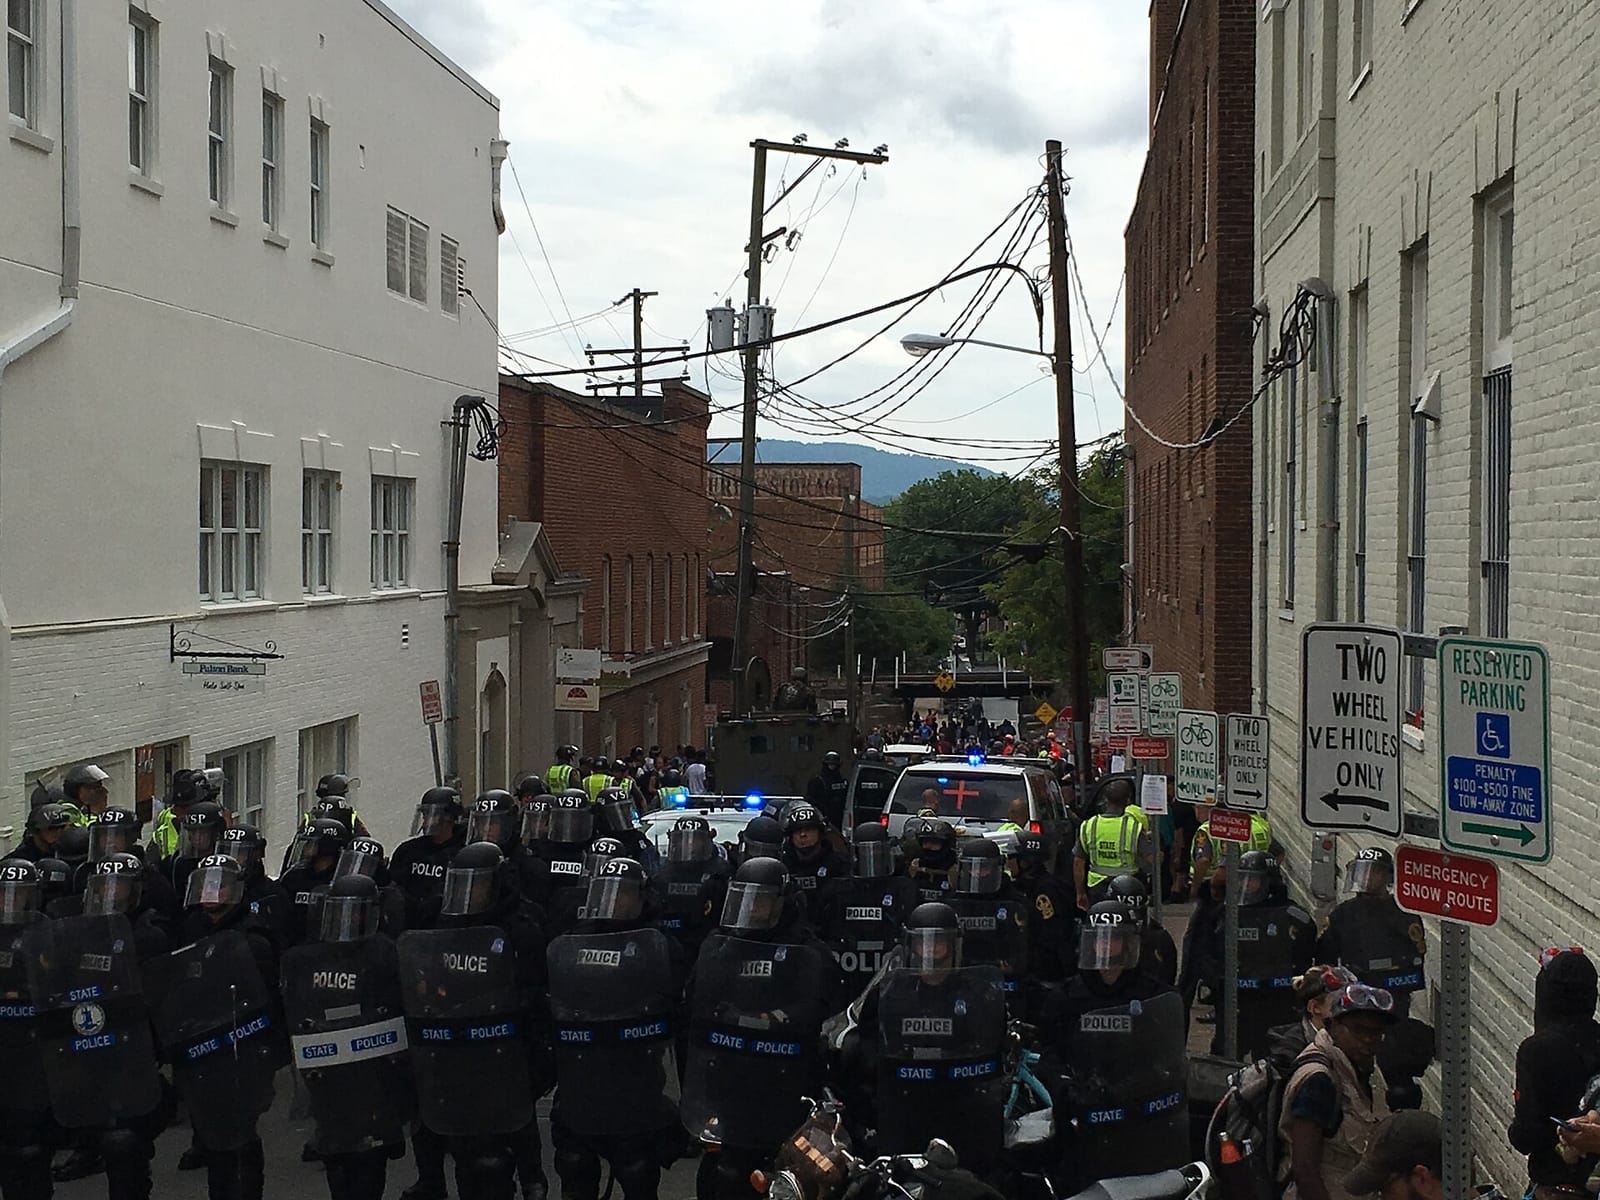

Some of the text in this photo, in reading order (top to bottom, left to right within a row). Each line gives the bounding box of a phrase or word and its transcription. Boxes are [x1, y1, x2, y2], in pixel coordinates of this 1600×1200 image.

[1335, 643, 1386, 684] TWO
[1453, 648, 1532, 681] RESERVED
[1460, 680, 1526, 712] PARKING
[1332, 692, 1388, 722] WHEEL
[1236, 718, 1260, 736] TWO
[1234, 740, 1261, 753] WHEEL
[1308, 727, 1398, 758] VEHICLES
[1180, 750, 1214, 765] BICYCLE
[1228, 754, 1267, 770] VEHICLES
[1179, 765, 1215, 780] PARKING
[1236, 770, 1257, 784] ONLY
[1336, 761, 1384, 792] ONLY
[1475, 764, 1517, 782] PENALTY
[609, 791, 626, 800] VS
[1186, 782, 1207, 796] ONLY
[1512, 787, 1534, 801] FINE
[474, 799, 499, 811] VSP
[558, 796, 582, 808] VSP
[1458, 794, 1536, 818] TOW-AWAY ZONE
[97, 811, 125, 823] VSP
[791, 809, 814, 822] VSP
[677, 821, 702, 831] VSP
[224, 829, 247, 841] VSP
[353, 840, 380, 855] VSP
[591, 841, 617, 854] VSP
[1358, 849, 1383, 861] VSP
[96, 861, 124, 874] VSP
[199, 854, 228, 868] VSP
[553, 862, 581, 874] POLIC
[411, 861, 444, 878] POLIC
[600, 862, 629, 876] VSP
[1404, 860, 1489, 890] EMERGENCY
[1116, 895, 1144, 907] VSP
[1402, 882, 1493, 913] SNOW ROUTE
[848, 908, 881, 919] POLICE
[1089, 912, 1123, 928] VSP
[443, 953, 488, 973] POLICE
[579, 951, 619, 965] POLICE
[312, 971, 358, 990] POLICE
[1388, 974, 1417, 987] POLICE
[70, 986, 100, 1001] STATE
[0, 1004, 35, 1016] POLICE
[905, 1019, 950, 1032] POLICE
[1084, 1016, 1130, 1030] POLICE
[422, 1024, 509, 1040] STATE POLICE
[560, 1023, 662, 1041] STATE POLICE
[75, 1034, 111, 1051] POLICE
[188, 1039, 219, 1059] STATE
[305, 1033, 393, 1058] STATE POLICE
[711, 1031, 795, 1055] STATE POLICE
[900, 1063, 992, 1079] STATE POLICE
[1090, 1092, 1180, 1124] STATE POLICE
